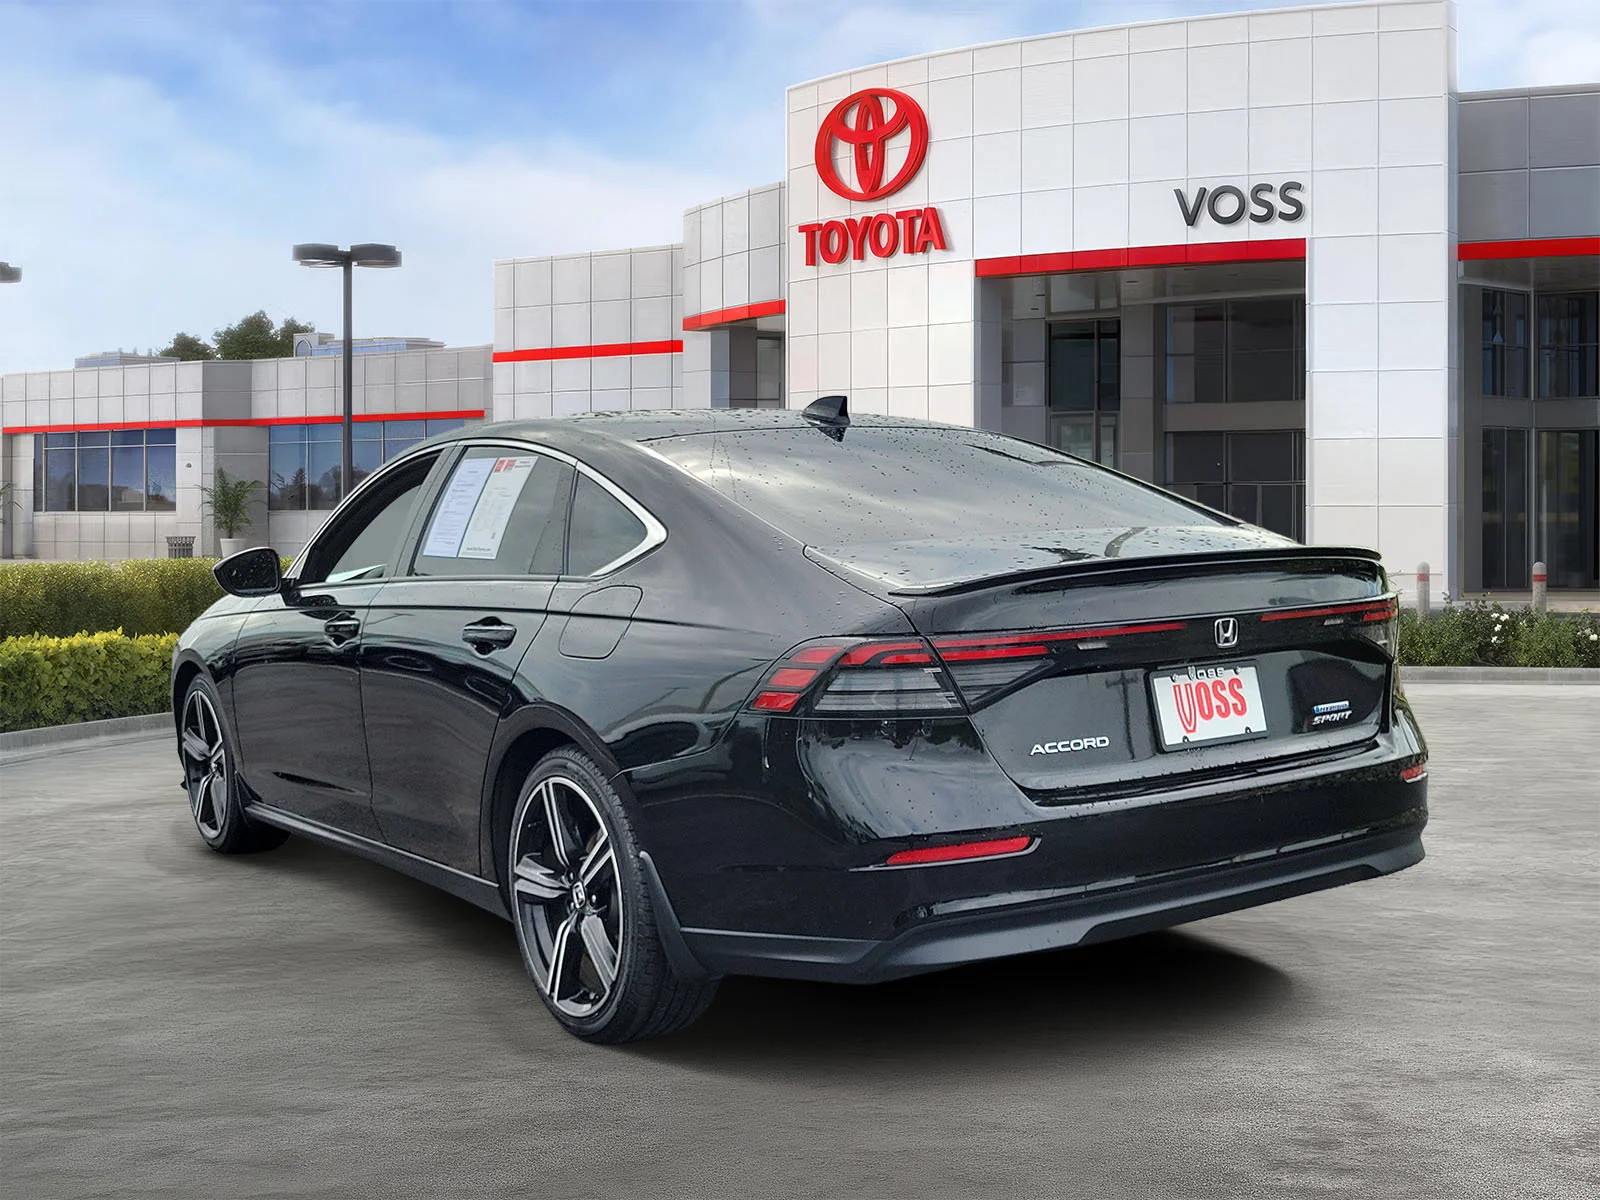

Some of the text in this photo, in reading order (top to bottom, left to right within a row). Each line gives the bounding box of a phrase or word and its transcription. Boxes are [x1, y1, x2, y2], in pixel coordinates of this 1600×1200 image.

[1173, 181, 1304, 227] VOSS
[798, 207, 947, 266] TOYOTA
[1173, 678, 1247, 733] VOSS
[1312, 710, 1353, 725] SPORT
[1030, 736, 1110, 756] ACCORD
